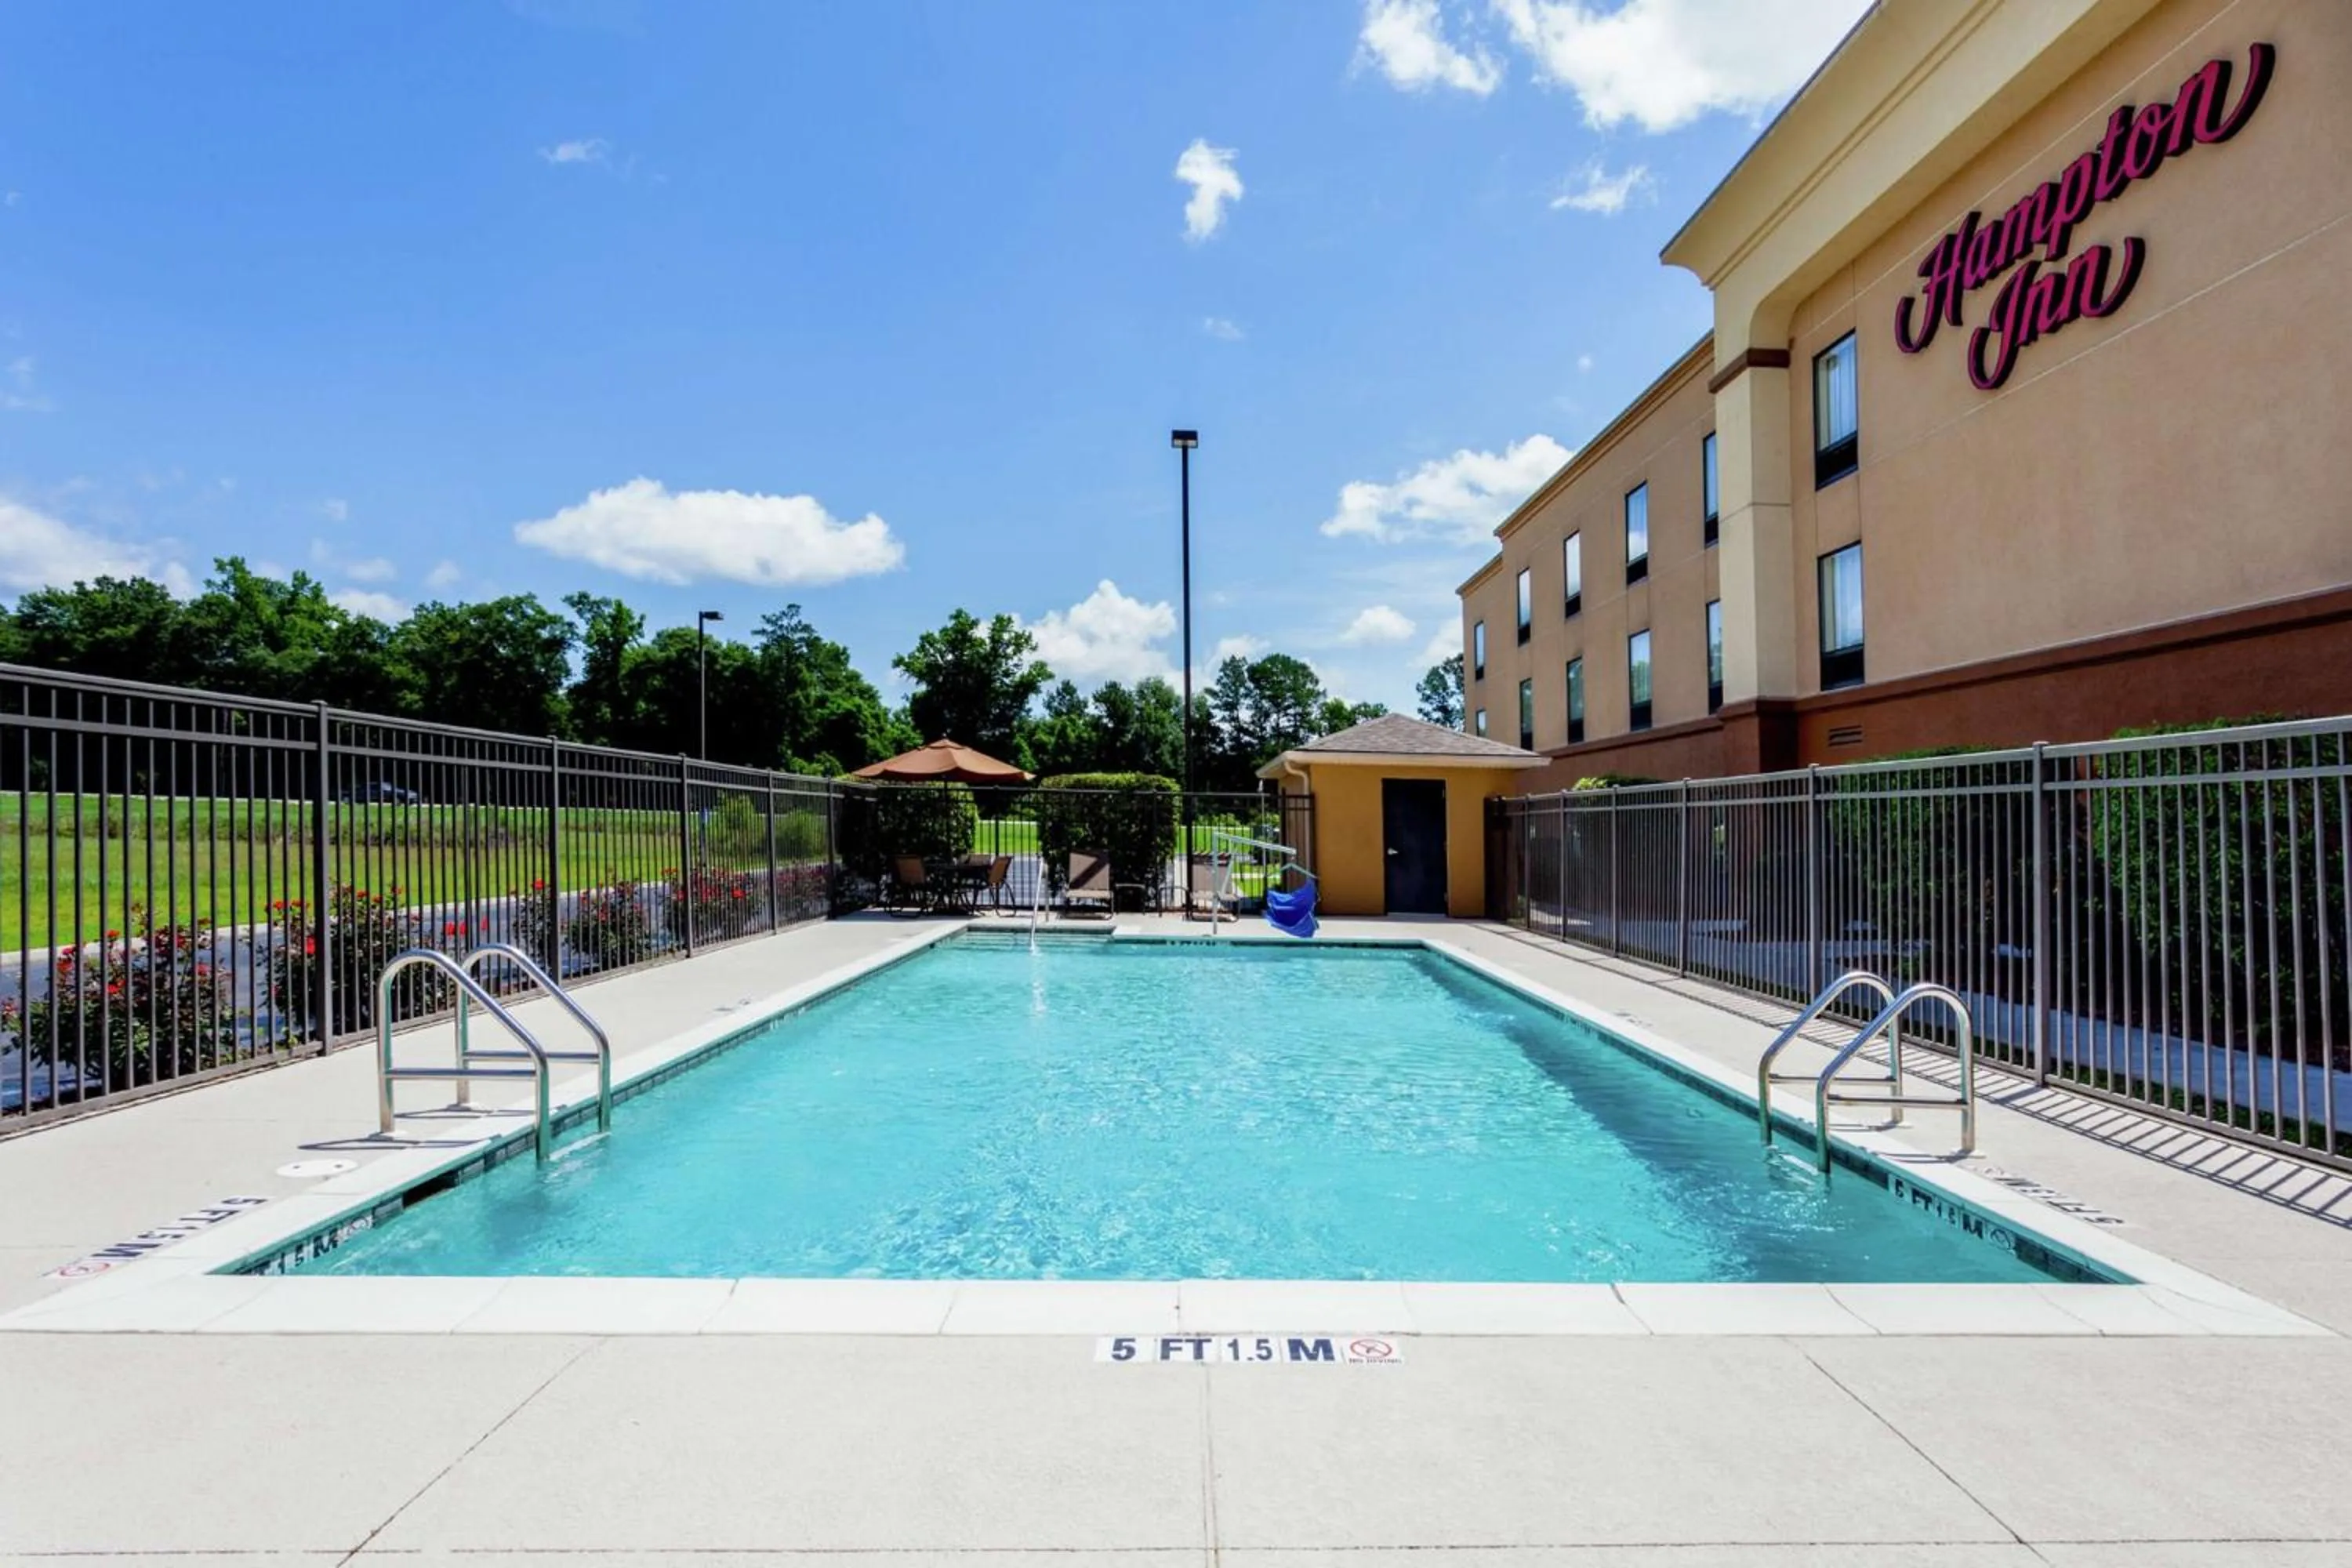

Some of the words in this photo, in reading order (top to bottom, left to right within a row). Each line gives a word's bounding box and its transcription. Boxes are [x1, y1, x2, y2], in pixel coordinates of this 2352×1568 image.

[1895, 42, 2276, 353] Hampton
[1967, 237, 2146, 390] Inn
[220, 1196, 268, 1206] 5
[177, 1209, 241, 1224] FT
[89, 1242, 163, 1258] M
[1110, 1338, 1137, 1362] 5
[1159, 1338, 1212, 1361] FT
[1226, 1338, 1273, 1362] 1.5
[1287, 1338, 1335, 1362] M
